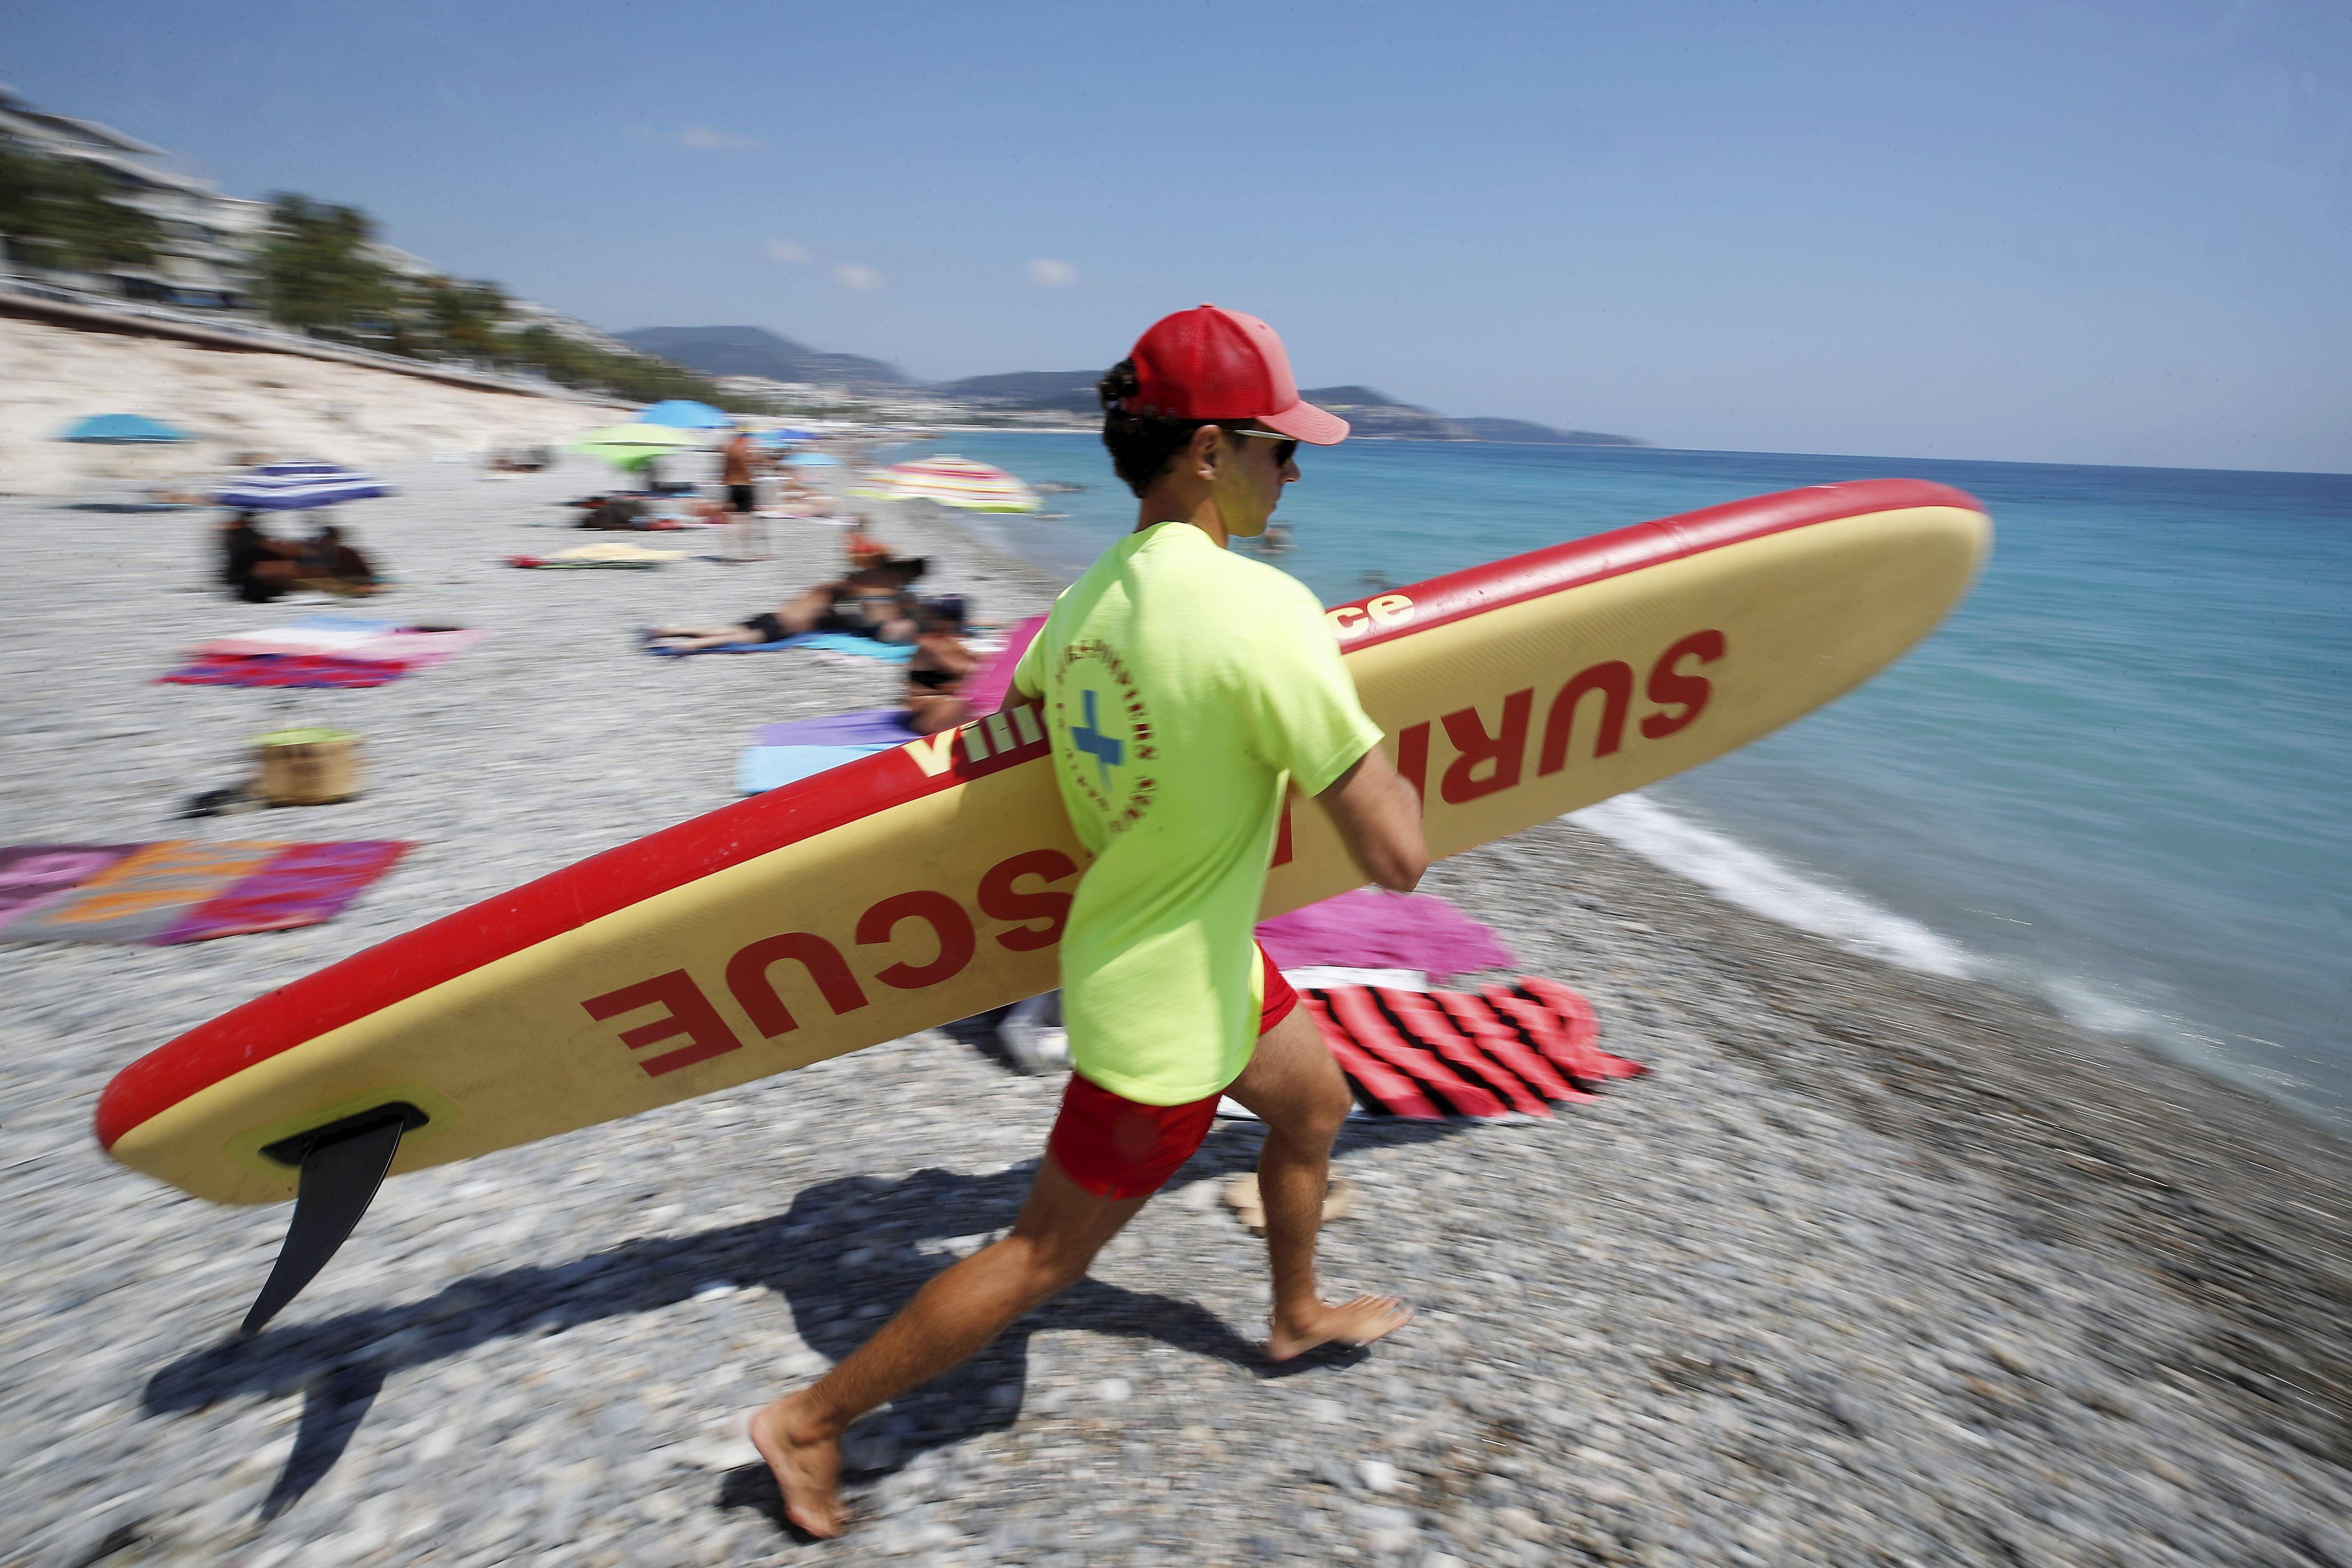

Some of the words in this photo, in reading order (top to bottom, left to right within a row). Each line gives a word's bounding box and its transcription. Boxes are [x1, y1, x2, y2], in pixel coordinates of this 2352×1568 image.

[900, 703, 1044, 778] Vill
[1325, 593, 1415, 640] ce
[580, 846, 1096, 1077] SCUE
